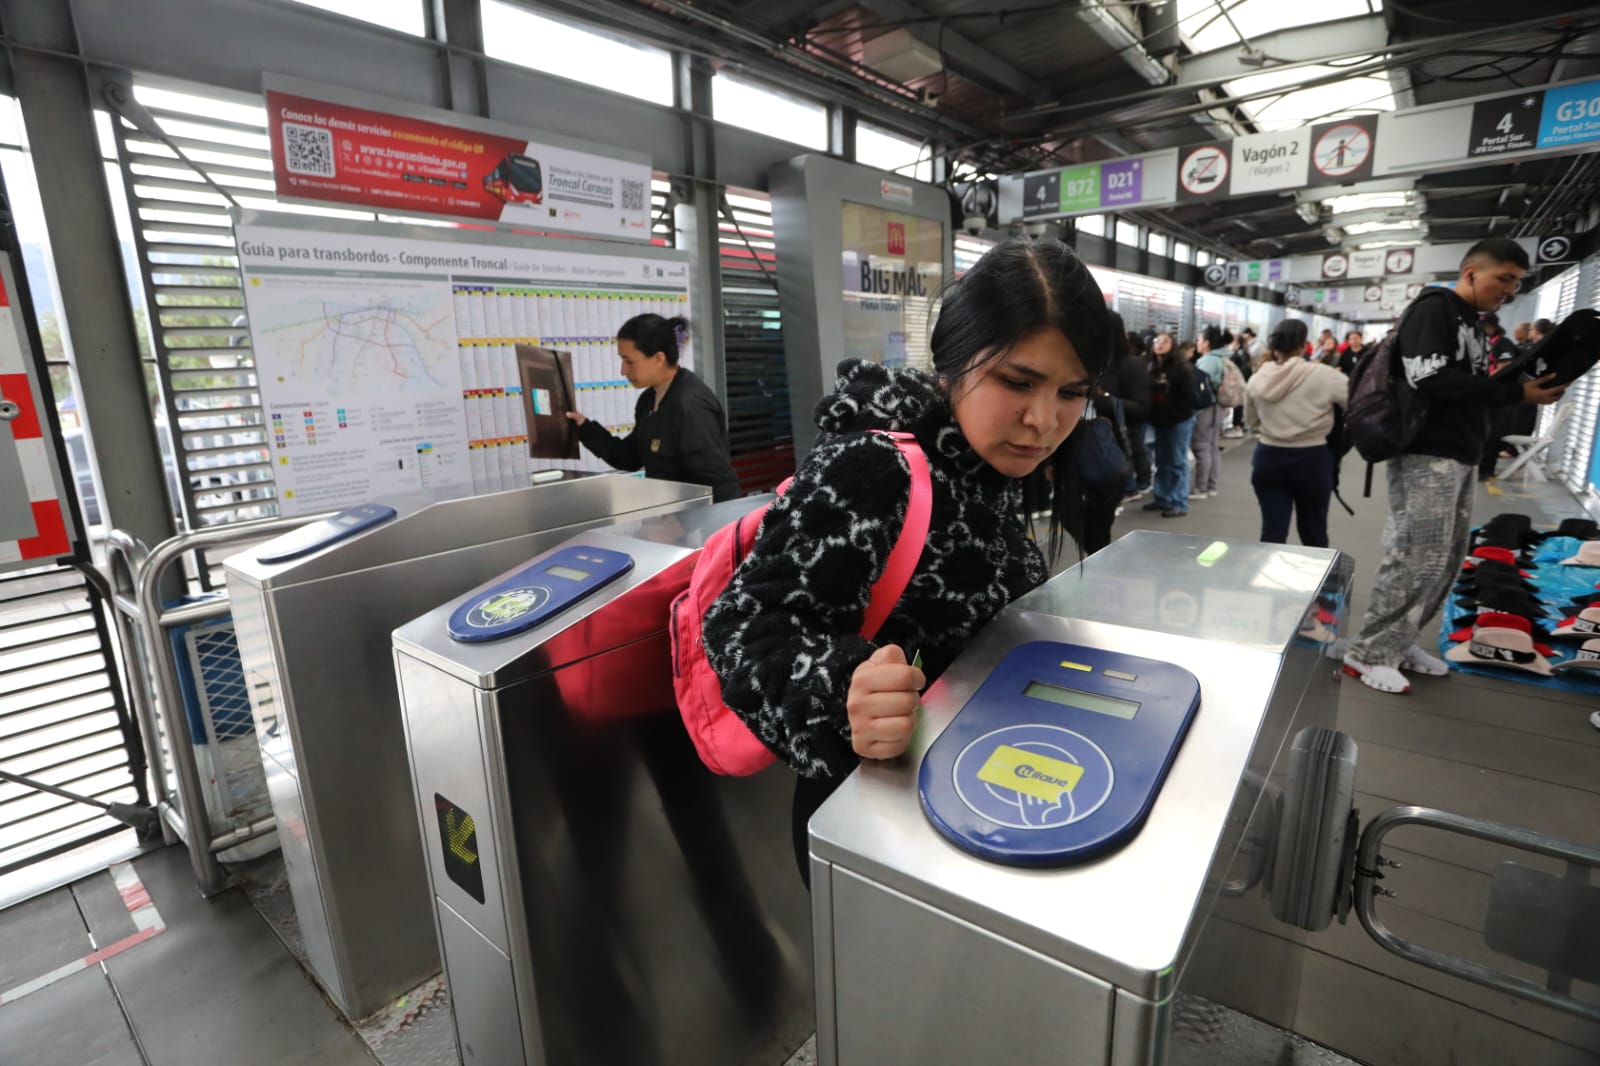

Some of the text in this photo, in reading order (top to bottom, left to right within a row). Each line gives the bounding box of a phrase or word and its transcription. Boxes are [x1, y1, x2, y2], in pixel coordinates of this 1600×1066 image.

[281, 107, 313, 123] Conoce
[314, 115, 327, 126] los
[328, 117, 356, 132] demás
[357, 122, 392, 138] servicios
[1496, 112, 1513, 133] 4
[1552, 122, 1583, 135] Portal
[1482, 133, 1525, 146] Portal Sur
[360, 143, 467, 170] www.transmilenio.gov.co
[1242, 141, 1299, 165] Vagón 2
[1284, 162, 1291, 173] 2
[548, 173, 580, 190] Troncal
[581, 177, 614, 196] Caracas
[1067, 179, 1095, 197] B72
[1109, 172, 1134, 189] D21
[1036, 185, 1047, 201] 4
[241, 240, 275, 257] Guía
[279, 247, 311, 261] para
[313, 248, 390, 264] transbordos
[399, 251, 469, 269] Componente
[471, 256, 507, 271] Troncal
[861, 260, 927, 297] BIG MAC
